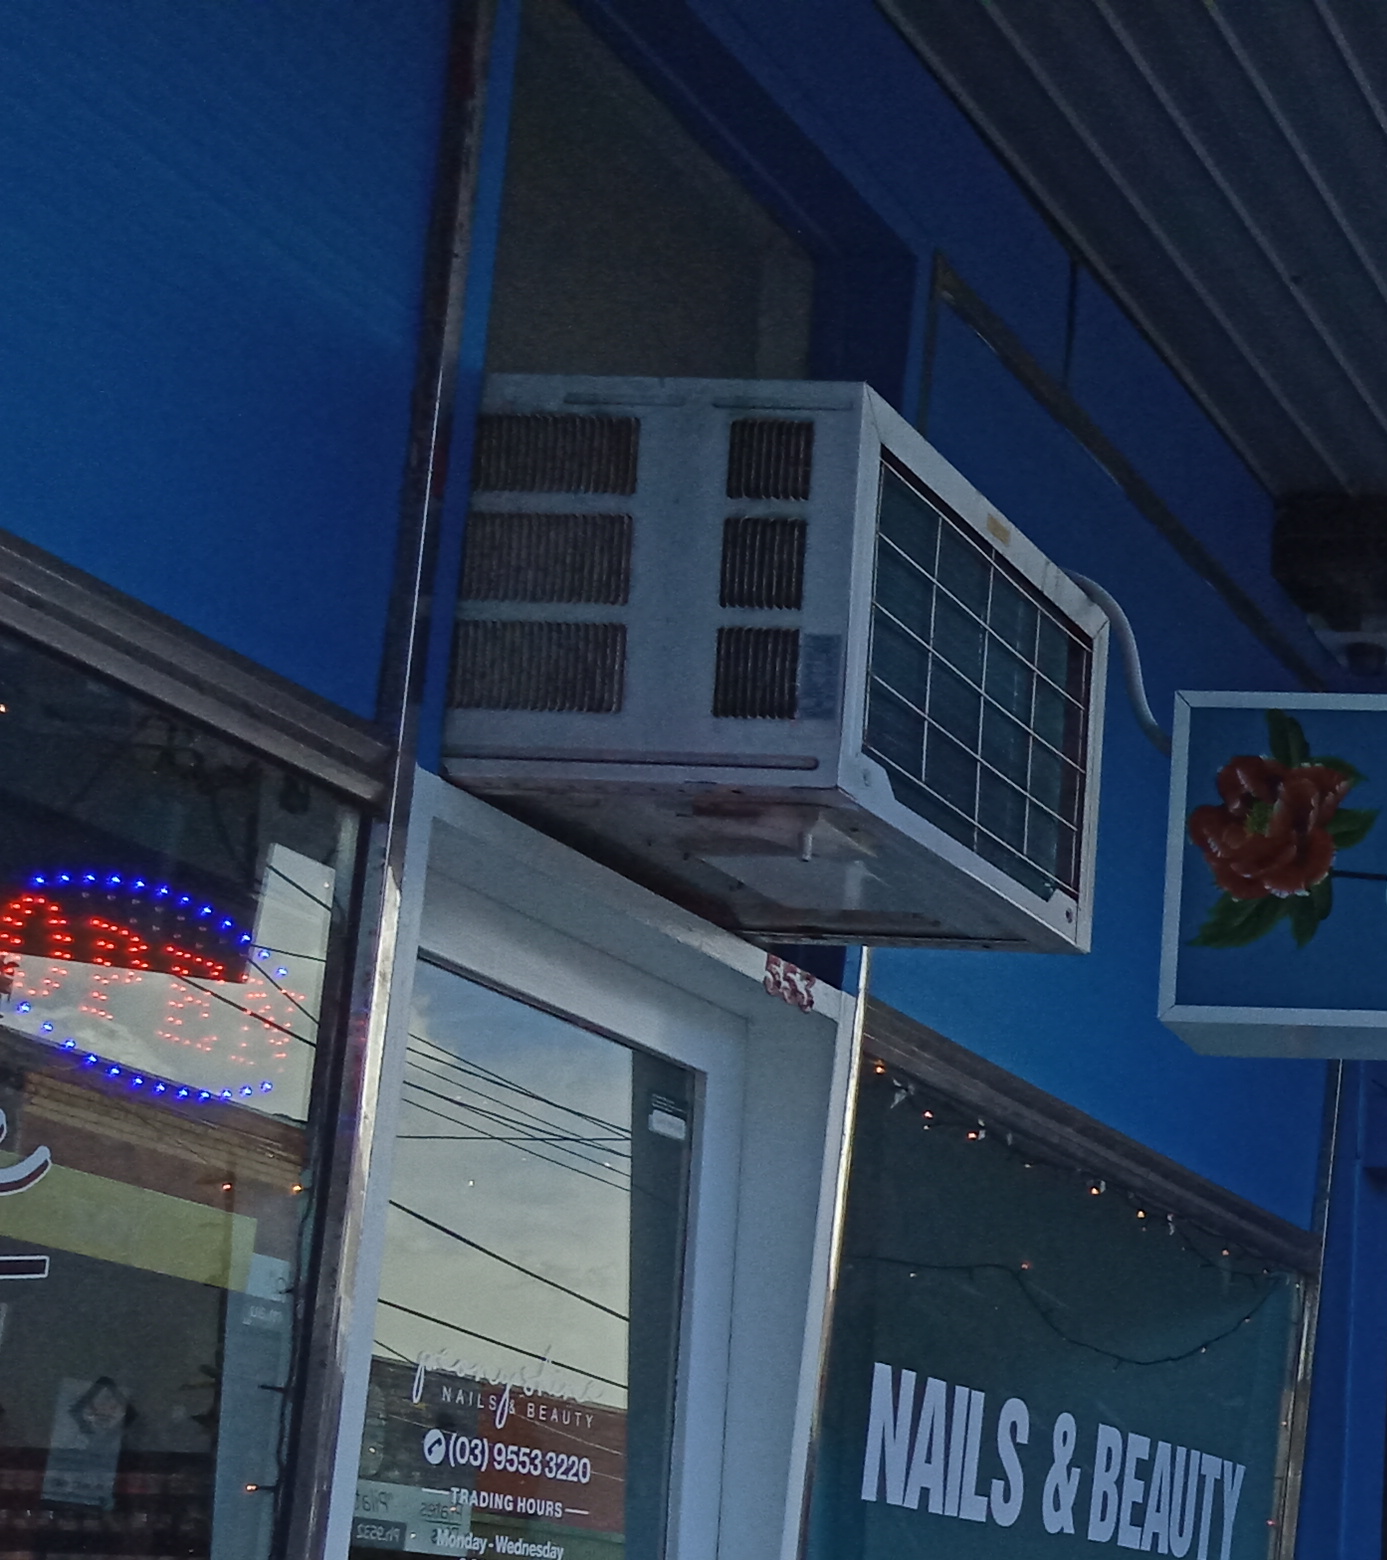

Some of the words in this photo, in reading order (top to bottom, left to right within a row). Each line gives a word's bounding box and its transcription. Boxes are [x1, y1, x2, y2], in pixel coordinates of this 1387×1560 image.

[442, 1385, 497, 1411] NAILS
[526, 1402, 595, 1429] BEAUTY
[449, 1432, 490, 1472] (03)
[493, 1442, 542, 1476] 9553
[544, 1451, 591, 1484] 3220
[860, 1361, 1030, 1528] NAILS
[1042, 1411, 1081, 1535] &
[450, 1486, 514, 1512] TRADING
[516, 1496, 563, 1518] HOURS
